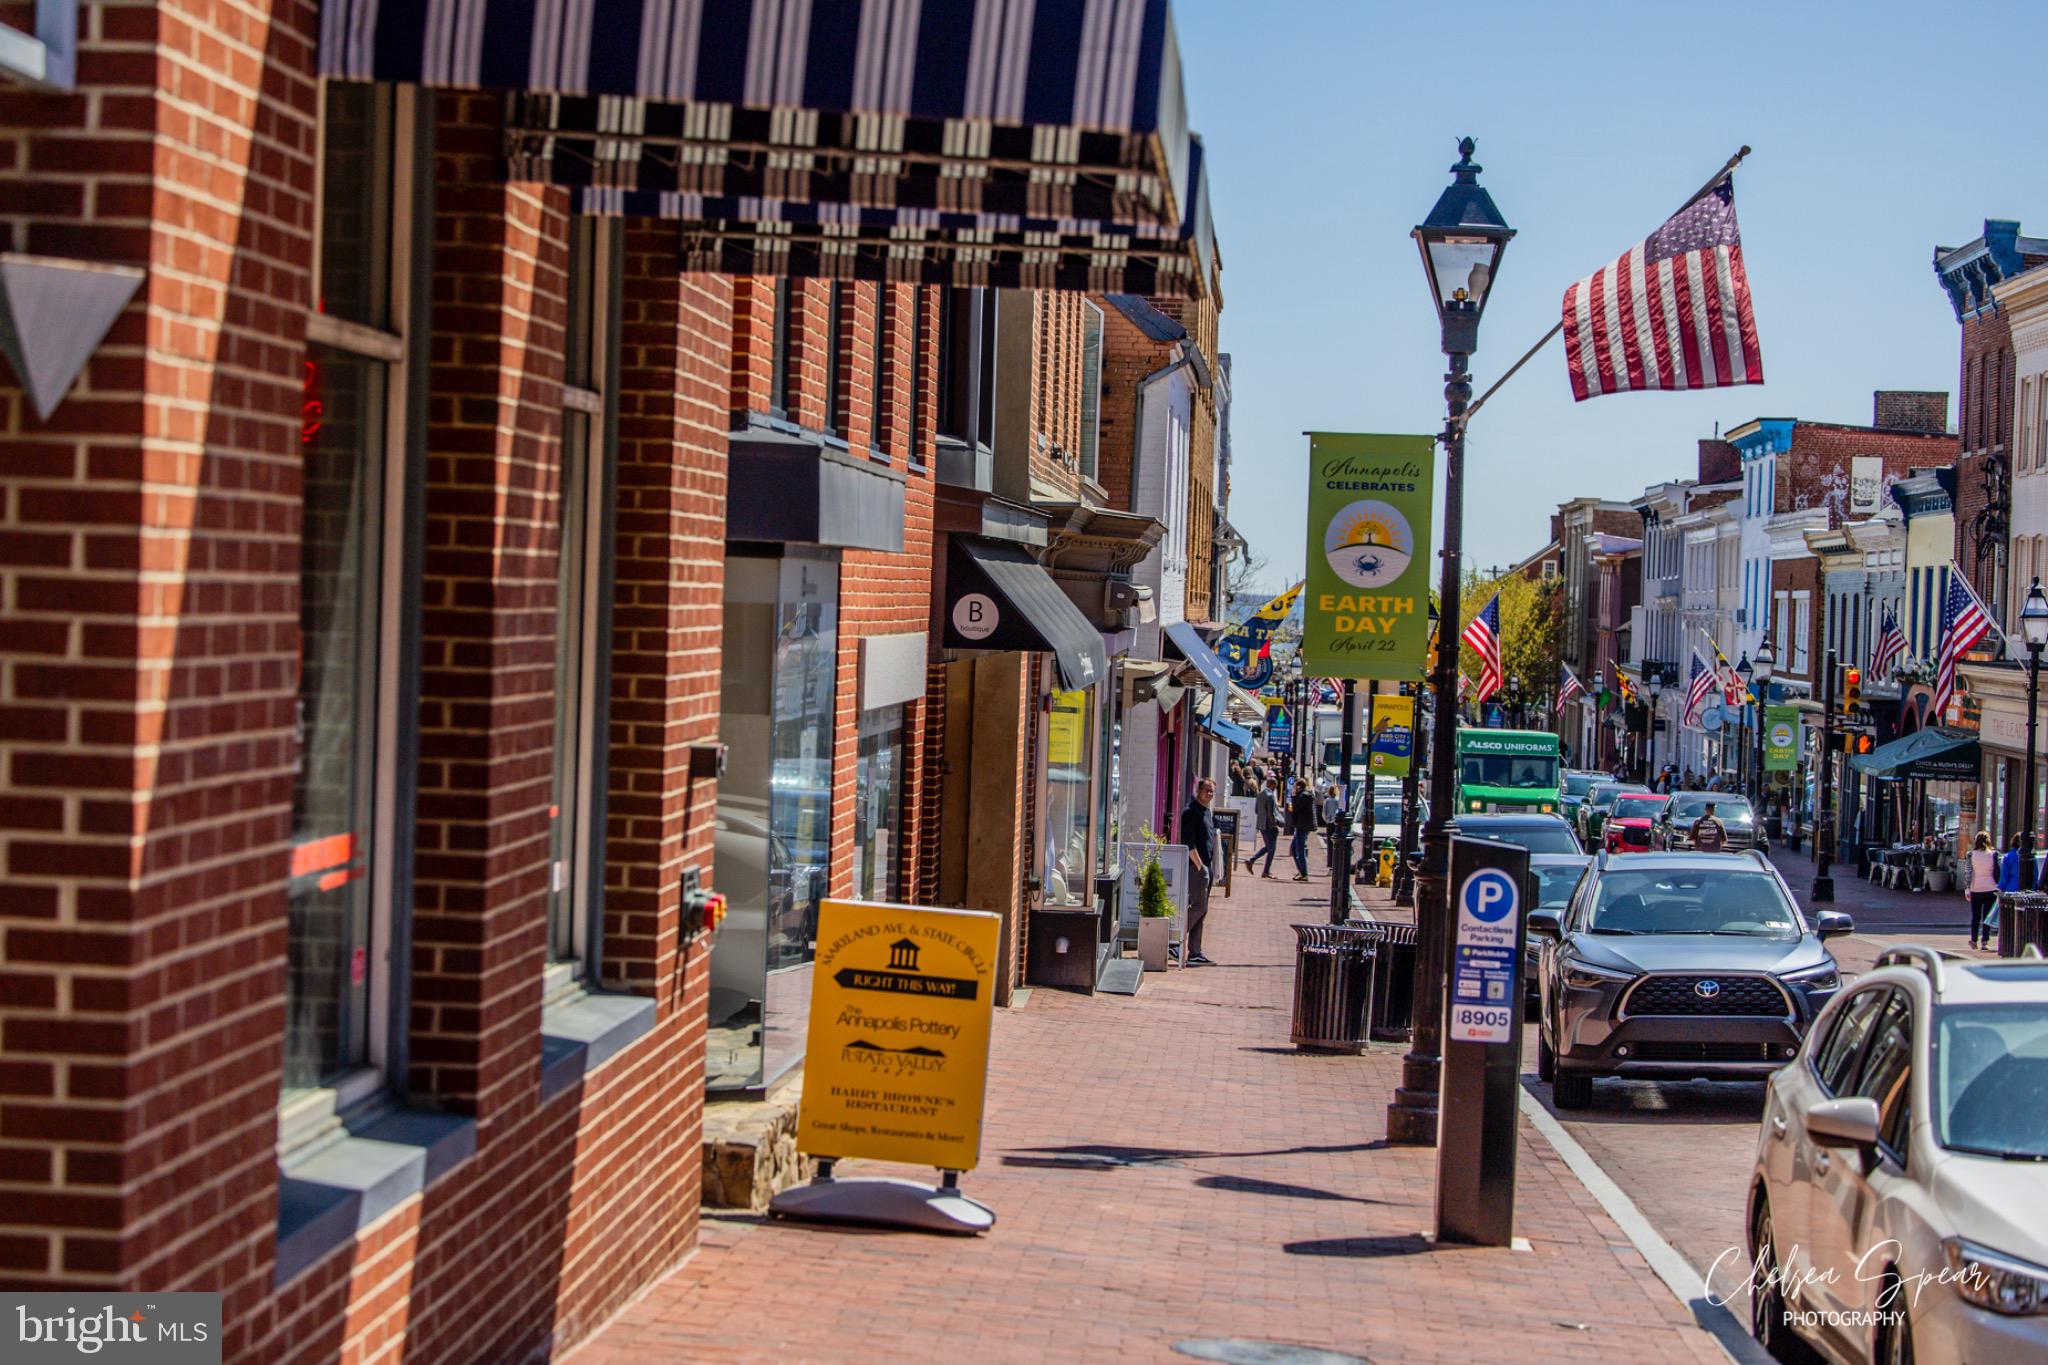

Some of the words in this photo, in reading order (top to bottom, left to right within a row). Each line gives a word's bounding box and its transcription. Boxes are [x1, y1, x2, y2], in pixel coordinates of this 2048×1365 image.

[1322, 456, 1420, 481] Annapolis
[1326, 481, 1415, 492] CELEBRATES
[969, 601, 983, 622] B
[1319, 594, 1414, 614] EARTH
[960, 625, 990, 633] boutique
[1335, 615, 1397, 635] DAY
[1329, 637, 1375, 654] April
[1377, 640, 1396, 652] 22
[1467, 740, 1501, 750] ALSCO
[1504, 742, 1553, 752] UNIFORMS
[1477, 881, 1503, 913] P
[1461, 923, 1513, 935] Contactless
[1470, 933, 1504, 945] Parking
[822, 924, 880, 967] MARYLAND
[909, 924, 919, 935] &
[922, 926, 953, 945] STATE
[956, 940, 988, 977] CIRCLE
[854, 974, 893, 989] RIGHT
[896, 977, 923, 992] THIS
[925, 980, 957, 995] WAY!
[836, 1010, 907, 1032] Annapolis
[909, 1017, 960, 1040] Pottery
[1461, 1010, 1508, 1027] 8905
[831, 1086, 879, 1099] HARRY
[883, 1091, 956, 1107] BROWNE'S
[845, 1100, 939, 1117] RESTAURANT
[811, 1119, 837, 1131] Great
[870, 1126, 924, 1138] Restaurants
[926, 1131, 935, 1141] &
[938, 1133, 965, 1143] More!
